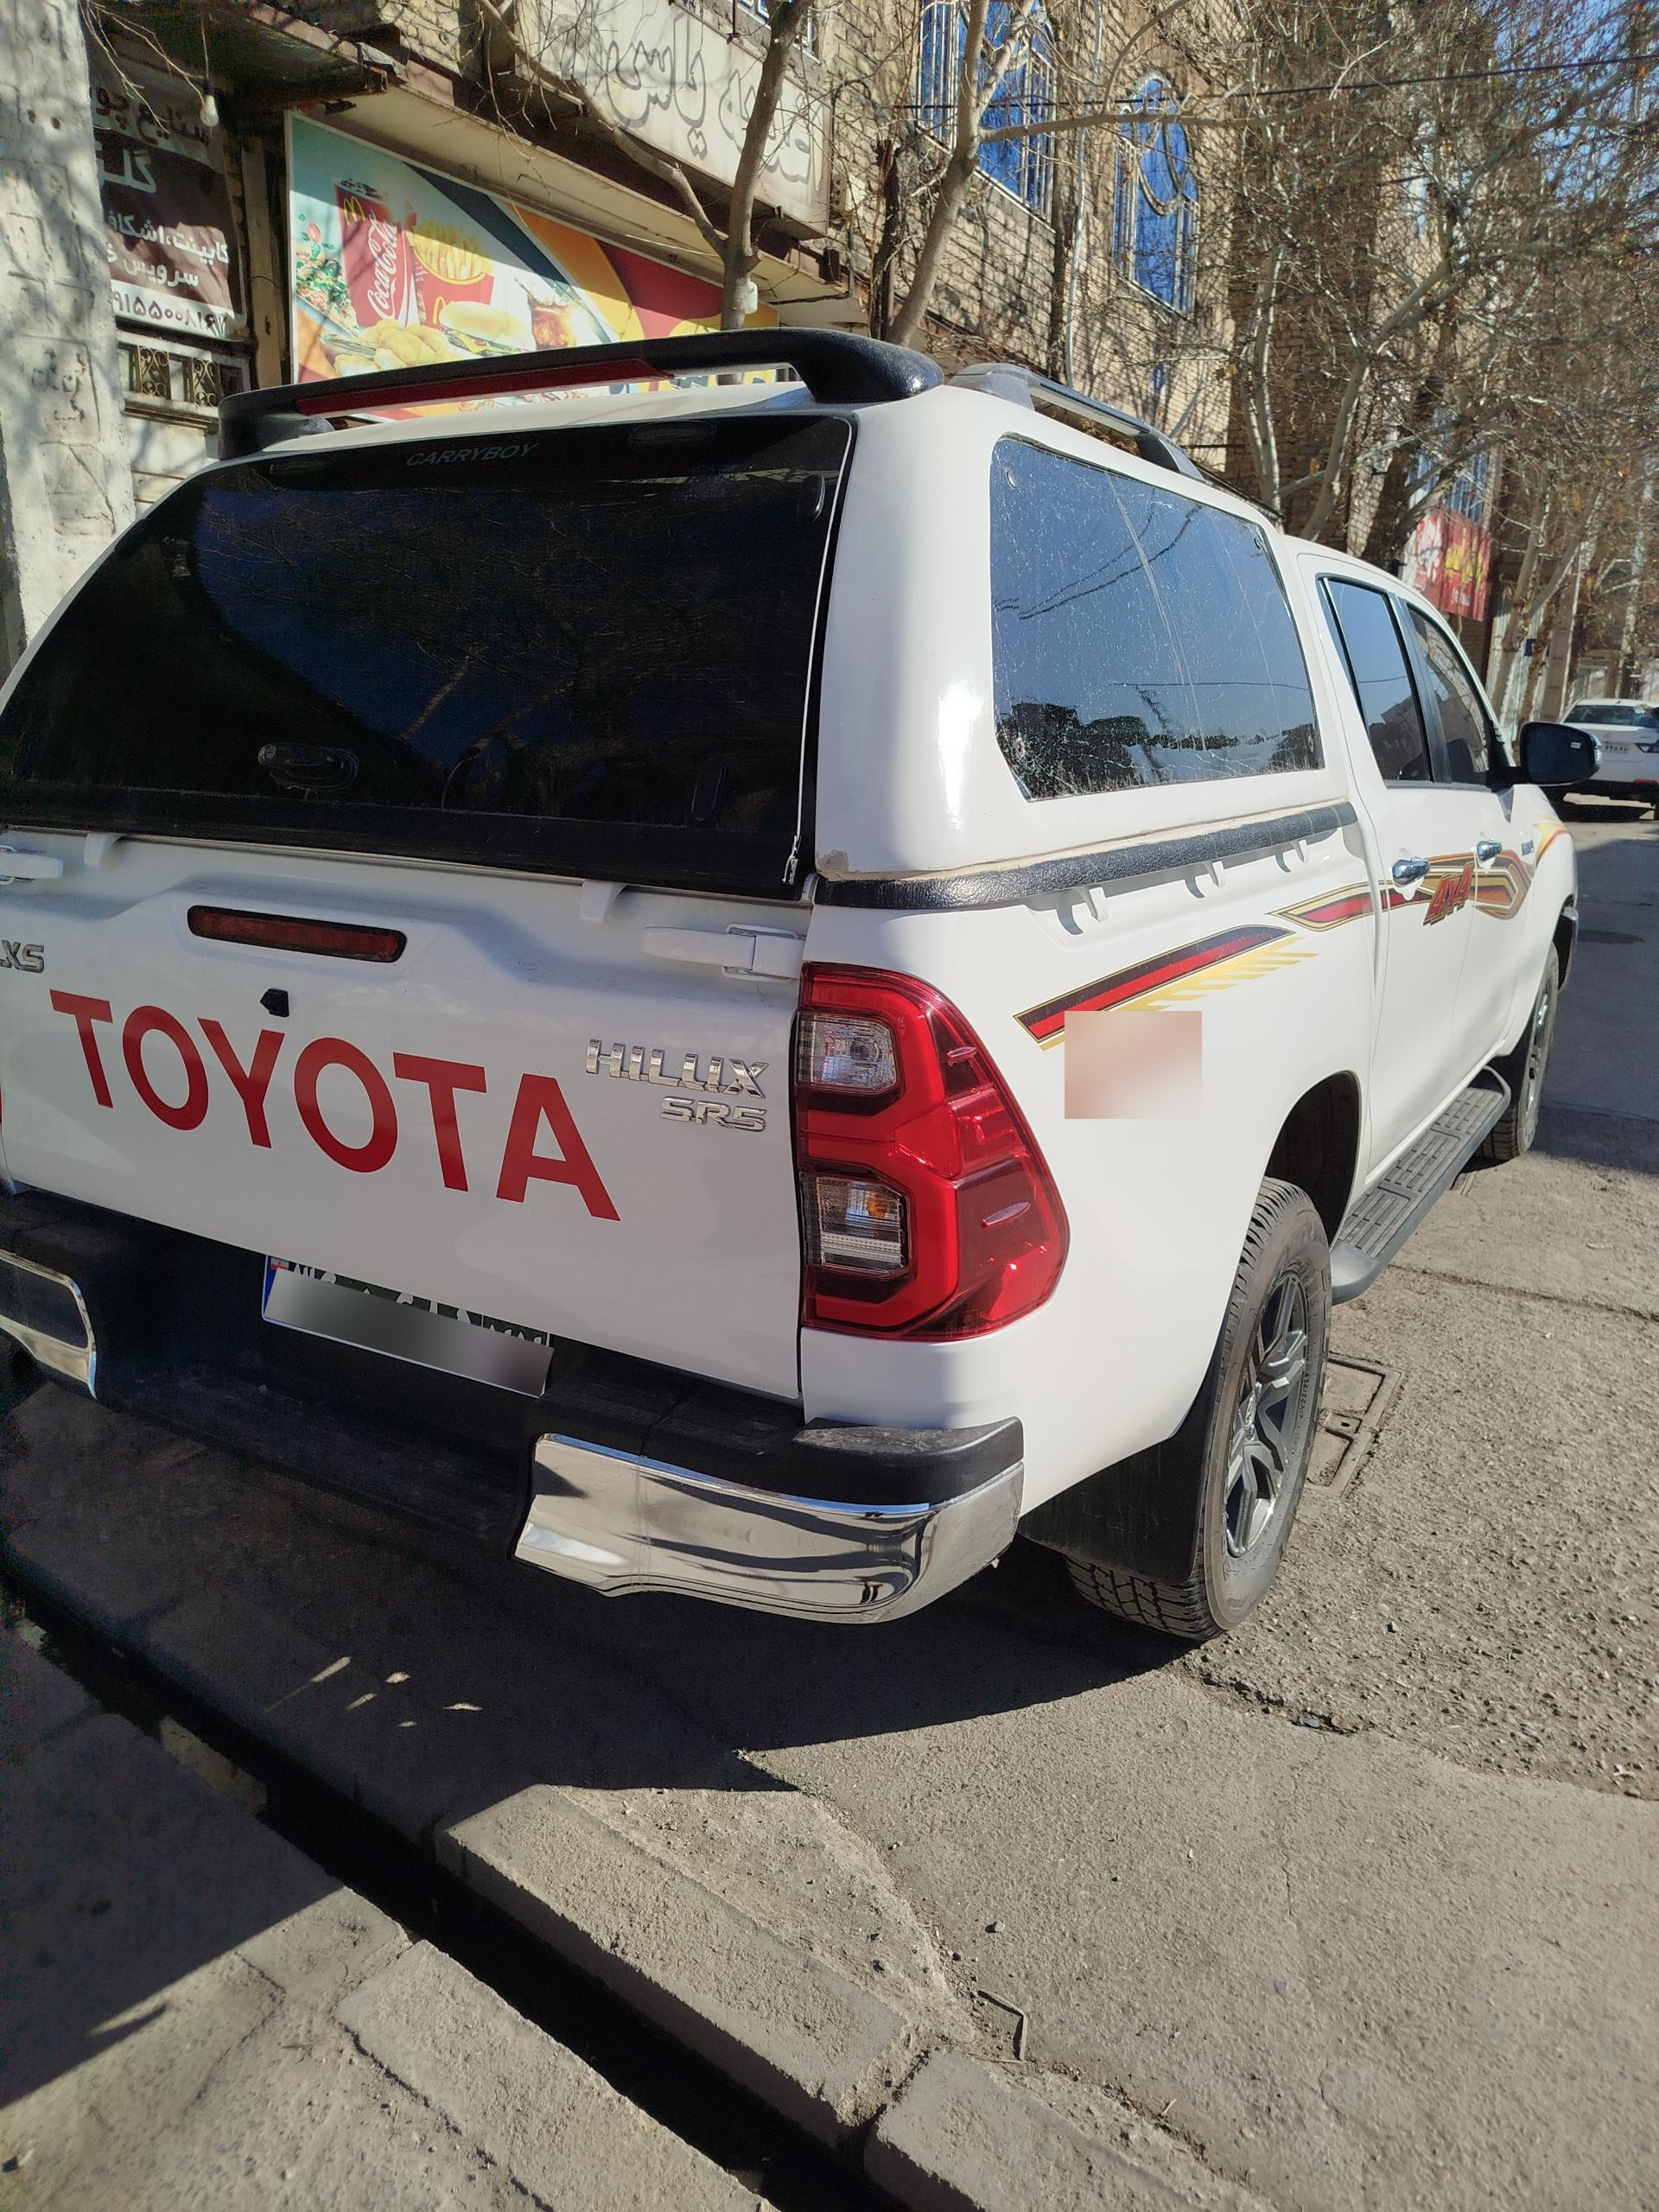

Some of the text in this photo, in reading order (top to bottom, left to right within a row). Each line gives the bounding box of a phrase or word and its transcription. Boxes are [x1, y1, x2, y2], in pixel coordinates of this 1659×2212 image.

[96, 87, 130, 130] چو
[123, 258, 199, 288] سرویس
[406, 442, 538, 467] CARRYBOY
[586, 1039, 770, 1099] HILUX
[49, 988, 621, 1222] TOYOTA
[659, 1095, 767, 1133] SR5
